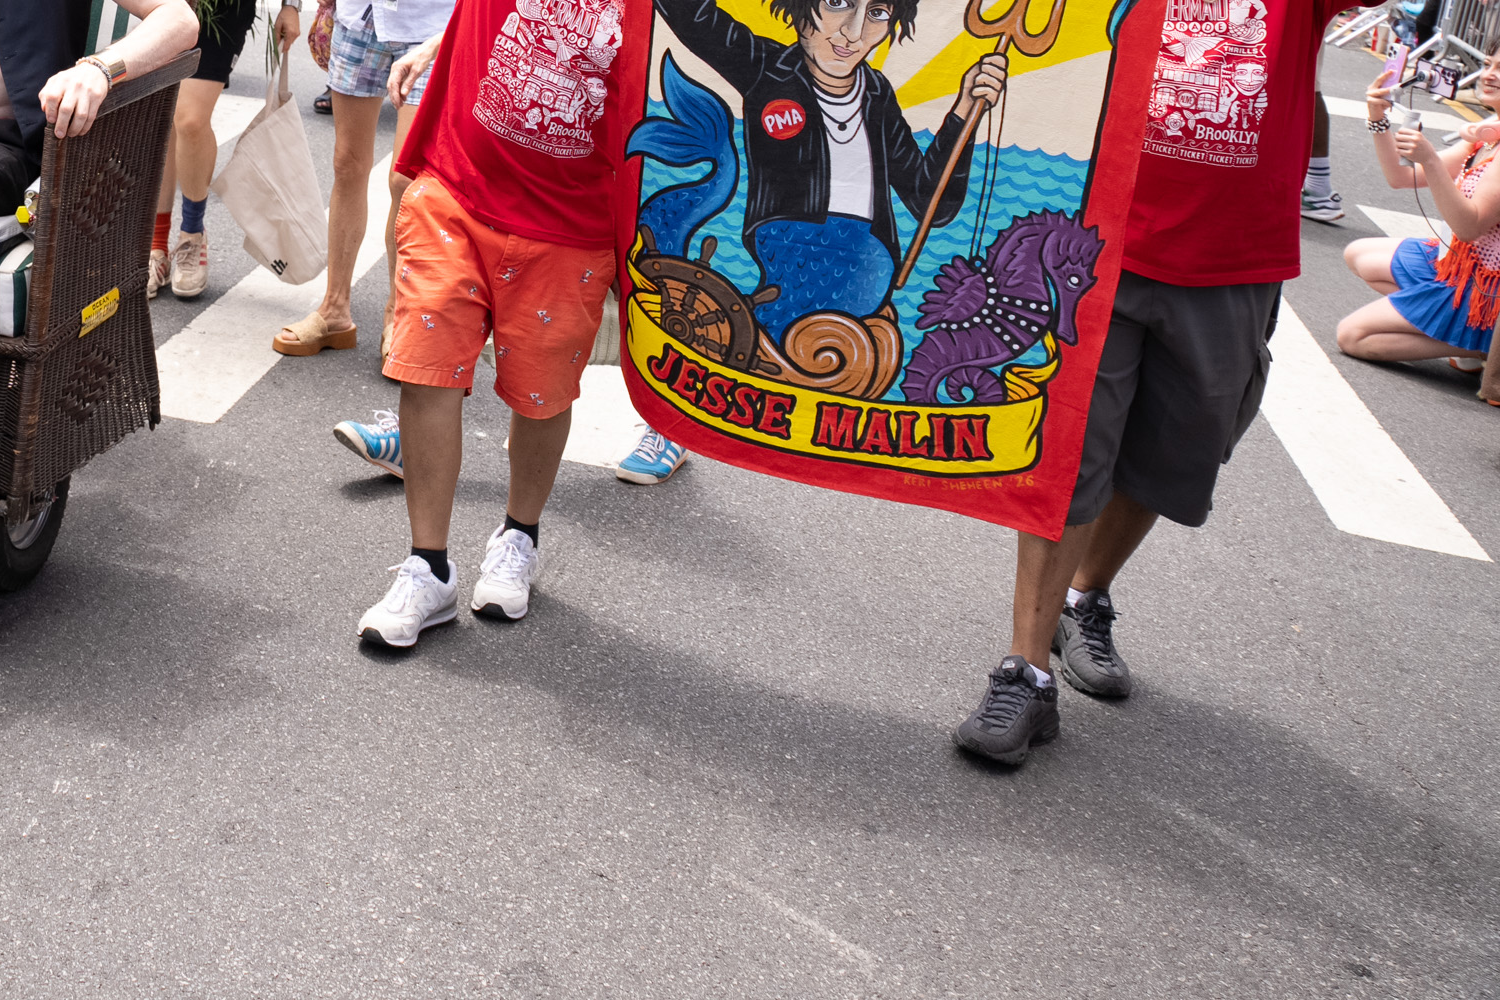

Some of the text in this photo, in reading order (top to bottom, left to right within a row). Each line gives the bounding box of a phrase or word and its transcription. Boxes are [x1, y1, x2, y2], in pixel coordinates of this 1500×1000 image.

[1163, 20, 1228, 34] ARADE
[1222, 44, 1259, 56] THRILLS
[764, 107, 804, 133] PMA
[489, 119, 509, 136] TICKET
[510, 131, 530, 145] TICKET
[531, 139, 553, 152] TICKET
[554, 148, 573, 156] TICKET
[1151, 143, 1177, 156] TICKET
[1180, 148, 1205, 162] TICKET
[1208, 153, 1234, 165] TICKET
[1235, 156, 1257, 166] TICKET
[645, 342, 996, 463] JESSE MALIN
[903, 475, 931, 487] KERI
